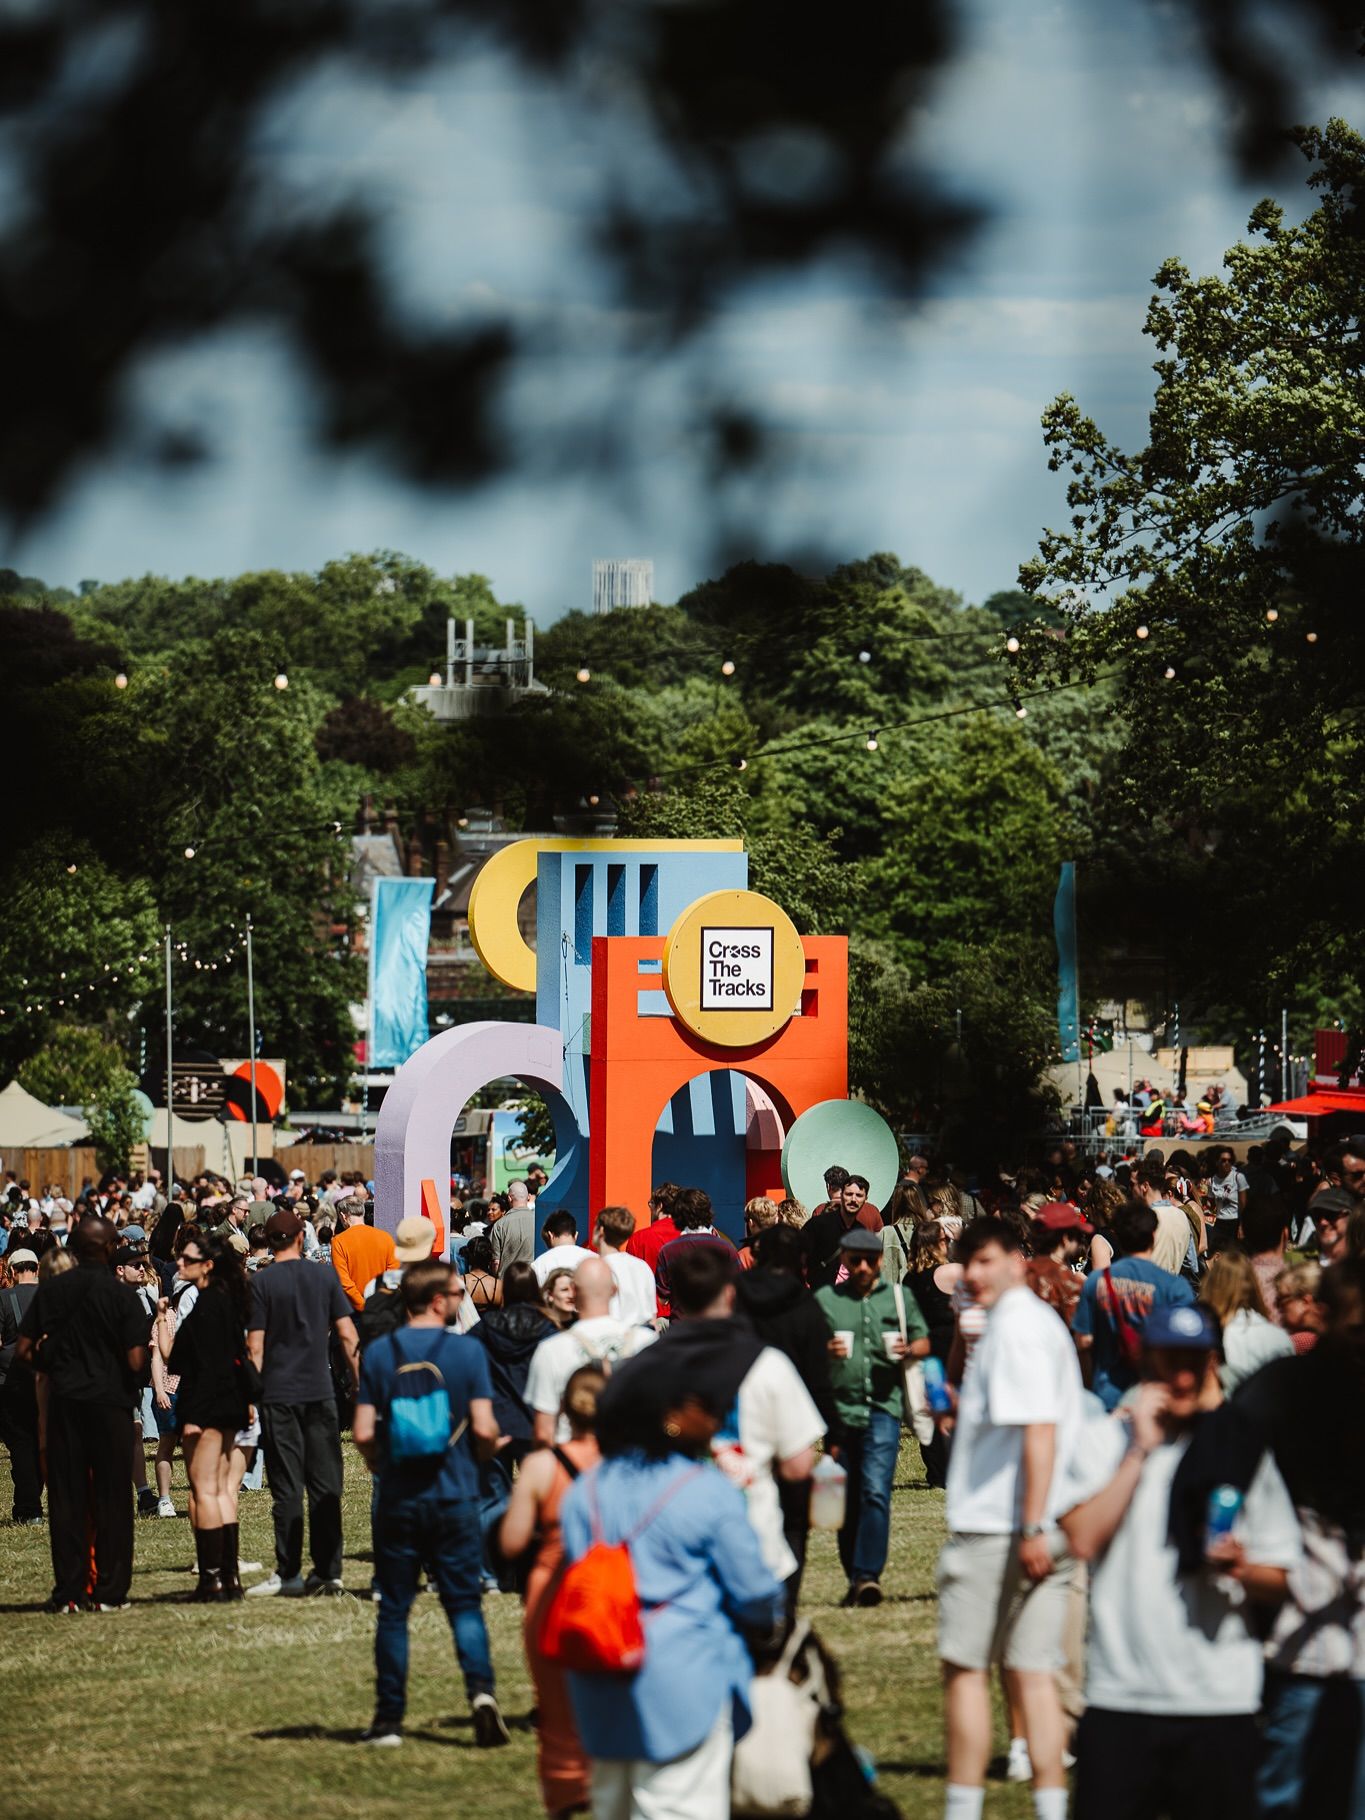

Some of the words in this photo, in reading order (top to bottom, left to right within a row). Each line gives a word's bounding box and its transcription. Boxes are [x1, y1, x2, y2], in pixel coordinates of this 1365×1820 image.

[708, 940, 761, 959] Cross
[708, 960, 742, 978] The
[708, 979, 766, 996] Tracks
